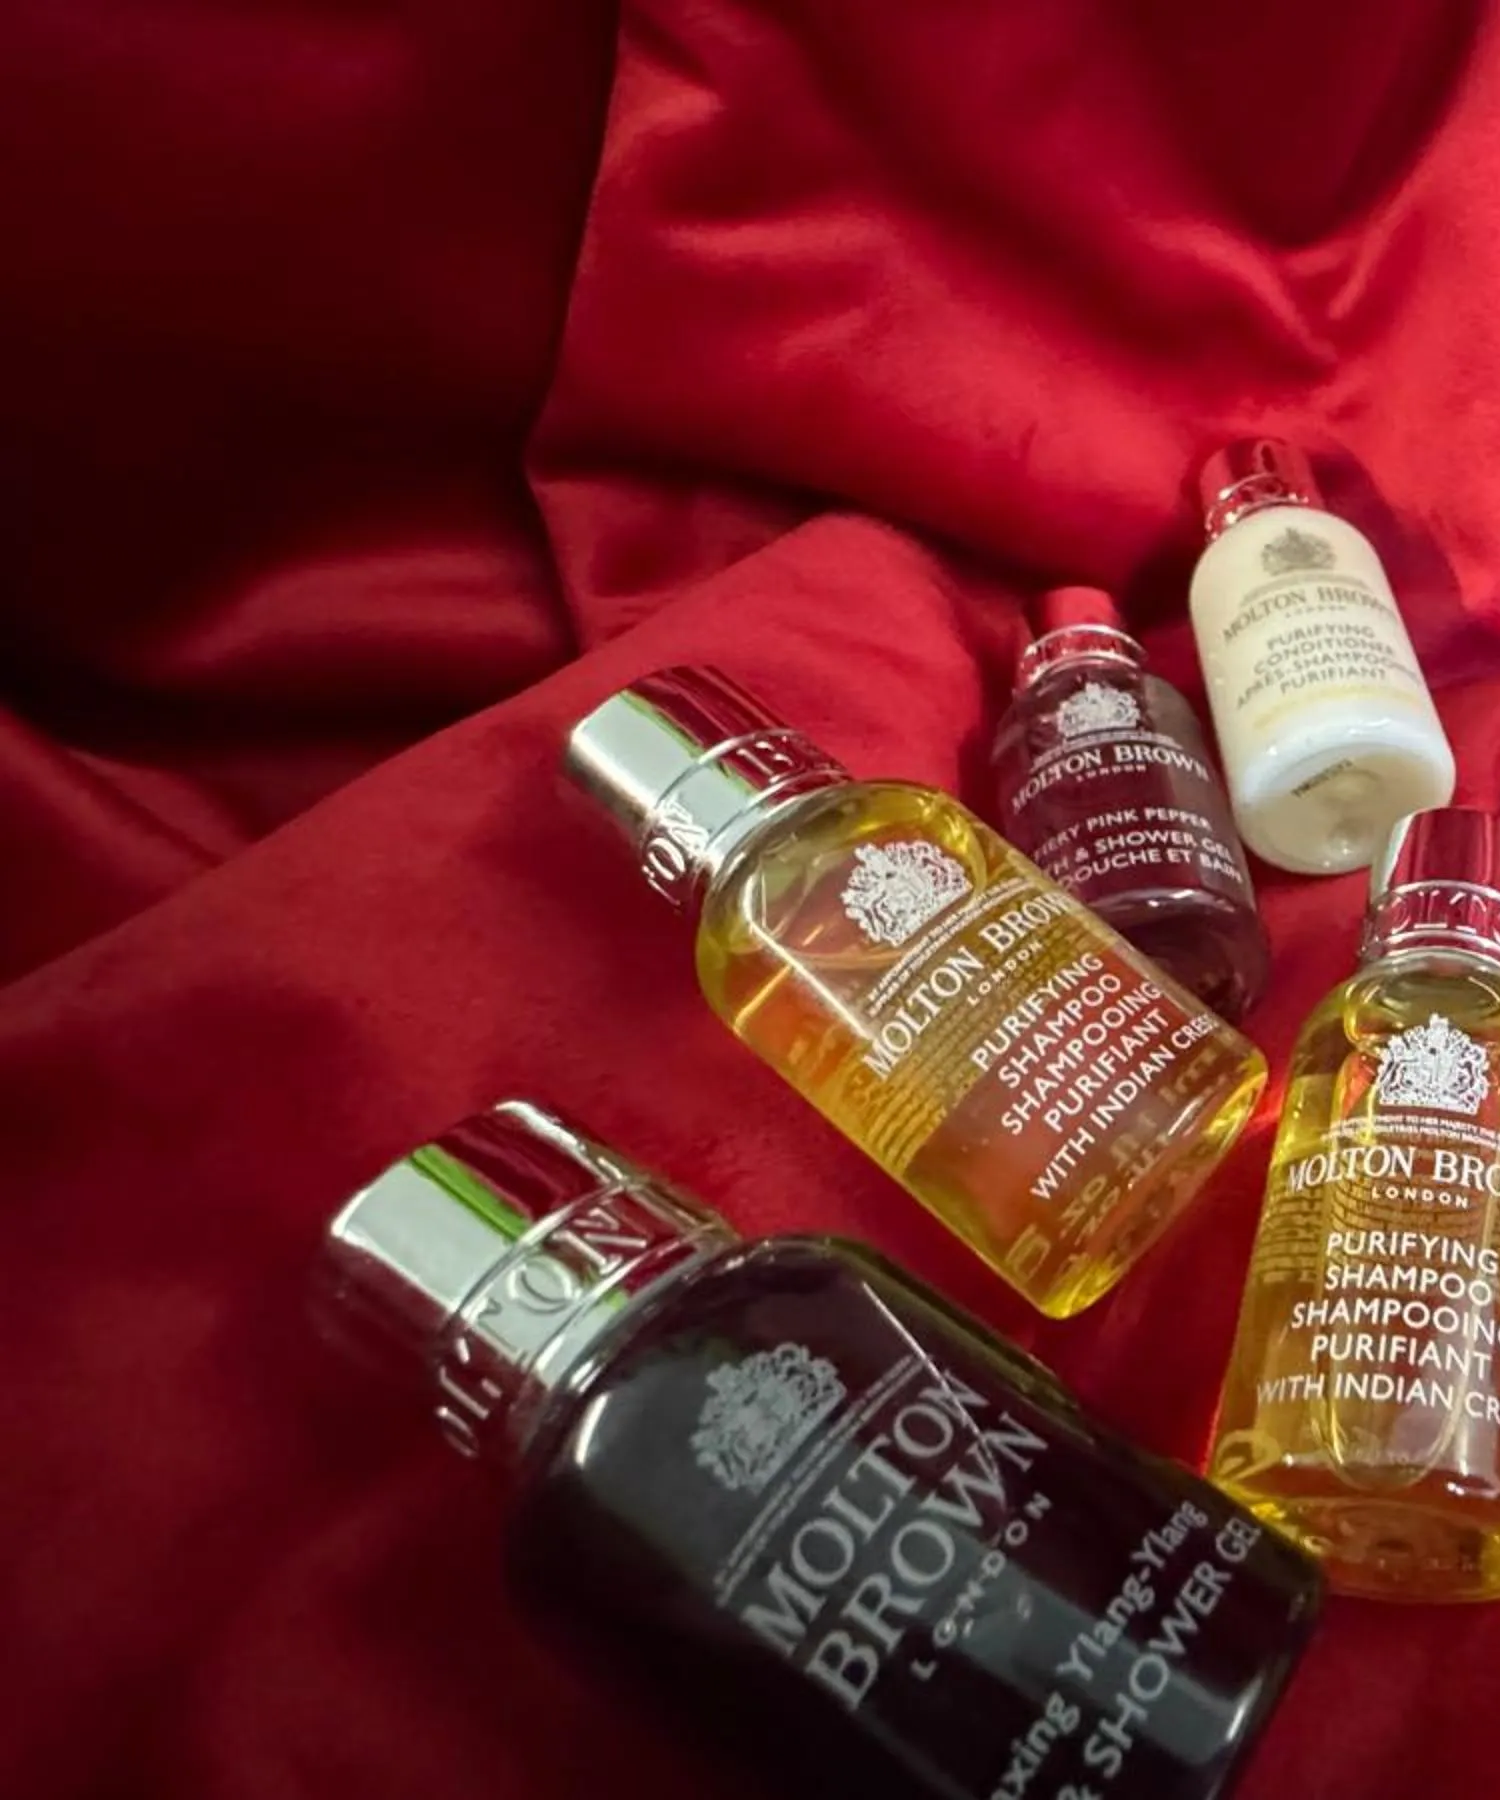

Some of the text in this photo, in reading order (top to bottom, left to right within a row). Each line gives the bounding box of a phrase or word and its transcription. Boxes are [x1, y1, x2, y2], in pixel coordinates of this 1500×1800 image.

[1223, 588, 1306, 642] MOLTON
[1267, 623, 1375, 650] PURIFYING
[1280, 666, 1386, 695] PURIFIANT
[1012, 748, 1102, 815] MOLTON
[1113, 745, 1210, 782] BROWN
[1075, 831, 1235, 863] & SHOWER GEL
[1087, 808, 1139, 832] PINK
[1144, 807, 1212, 832] PEPPER
[1168, 849, 1192, 864] ET
[1200, 853, 1243, 883] BAIN
[861, 947, 984, 1081] MOLTON
[978, 890, 1071, 953] BROW
[966, 940, 1043, 1007] LONDON
[970, 952, 1104, 1072] PURIFYING
[998, 974, 1122, 1088] SHAMPOO
[1000, 980, 1163, 1136] SHAMPOOING
[1043, 1008, 1170, 1132] PURIFIANT
[1030, 1129, 1096, 1200] WITH
[1090, 1045, 1176, 1131] INDIAN
[1287, 1144, 1417, 1194] MOLTON
[1371, 1186, 1470, 1210] LONDON
[1325, 1265, 1493, 1306] SHAMPOO
[1326, 1232, 1499, 1275] PURIFYING
[1311, 1334, 1491, 1381] PURIFIANT
[1257, 1373, 1324, 1405] WITH
[1334, 1372, 1454, 1412] INDIAN
[740, 1370, 990, 1659] MOLTON
[803, 1411, 1049, 1712] BROWN
[910, 1491, 1052, 1681] LONDON
[1055, 1500, 1209, 1682] Ylang-Ylang
[1083, 1516, 1263, 1780] SHOWER GEL
